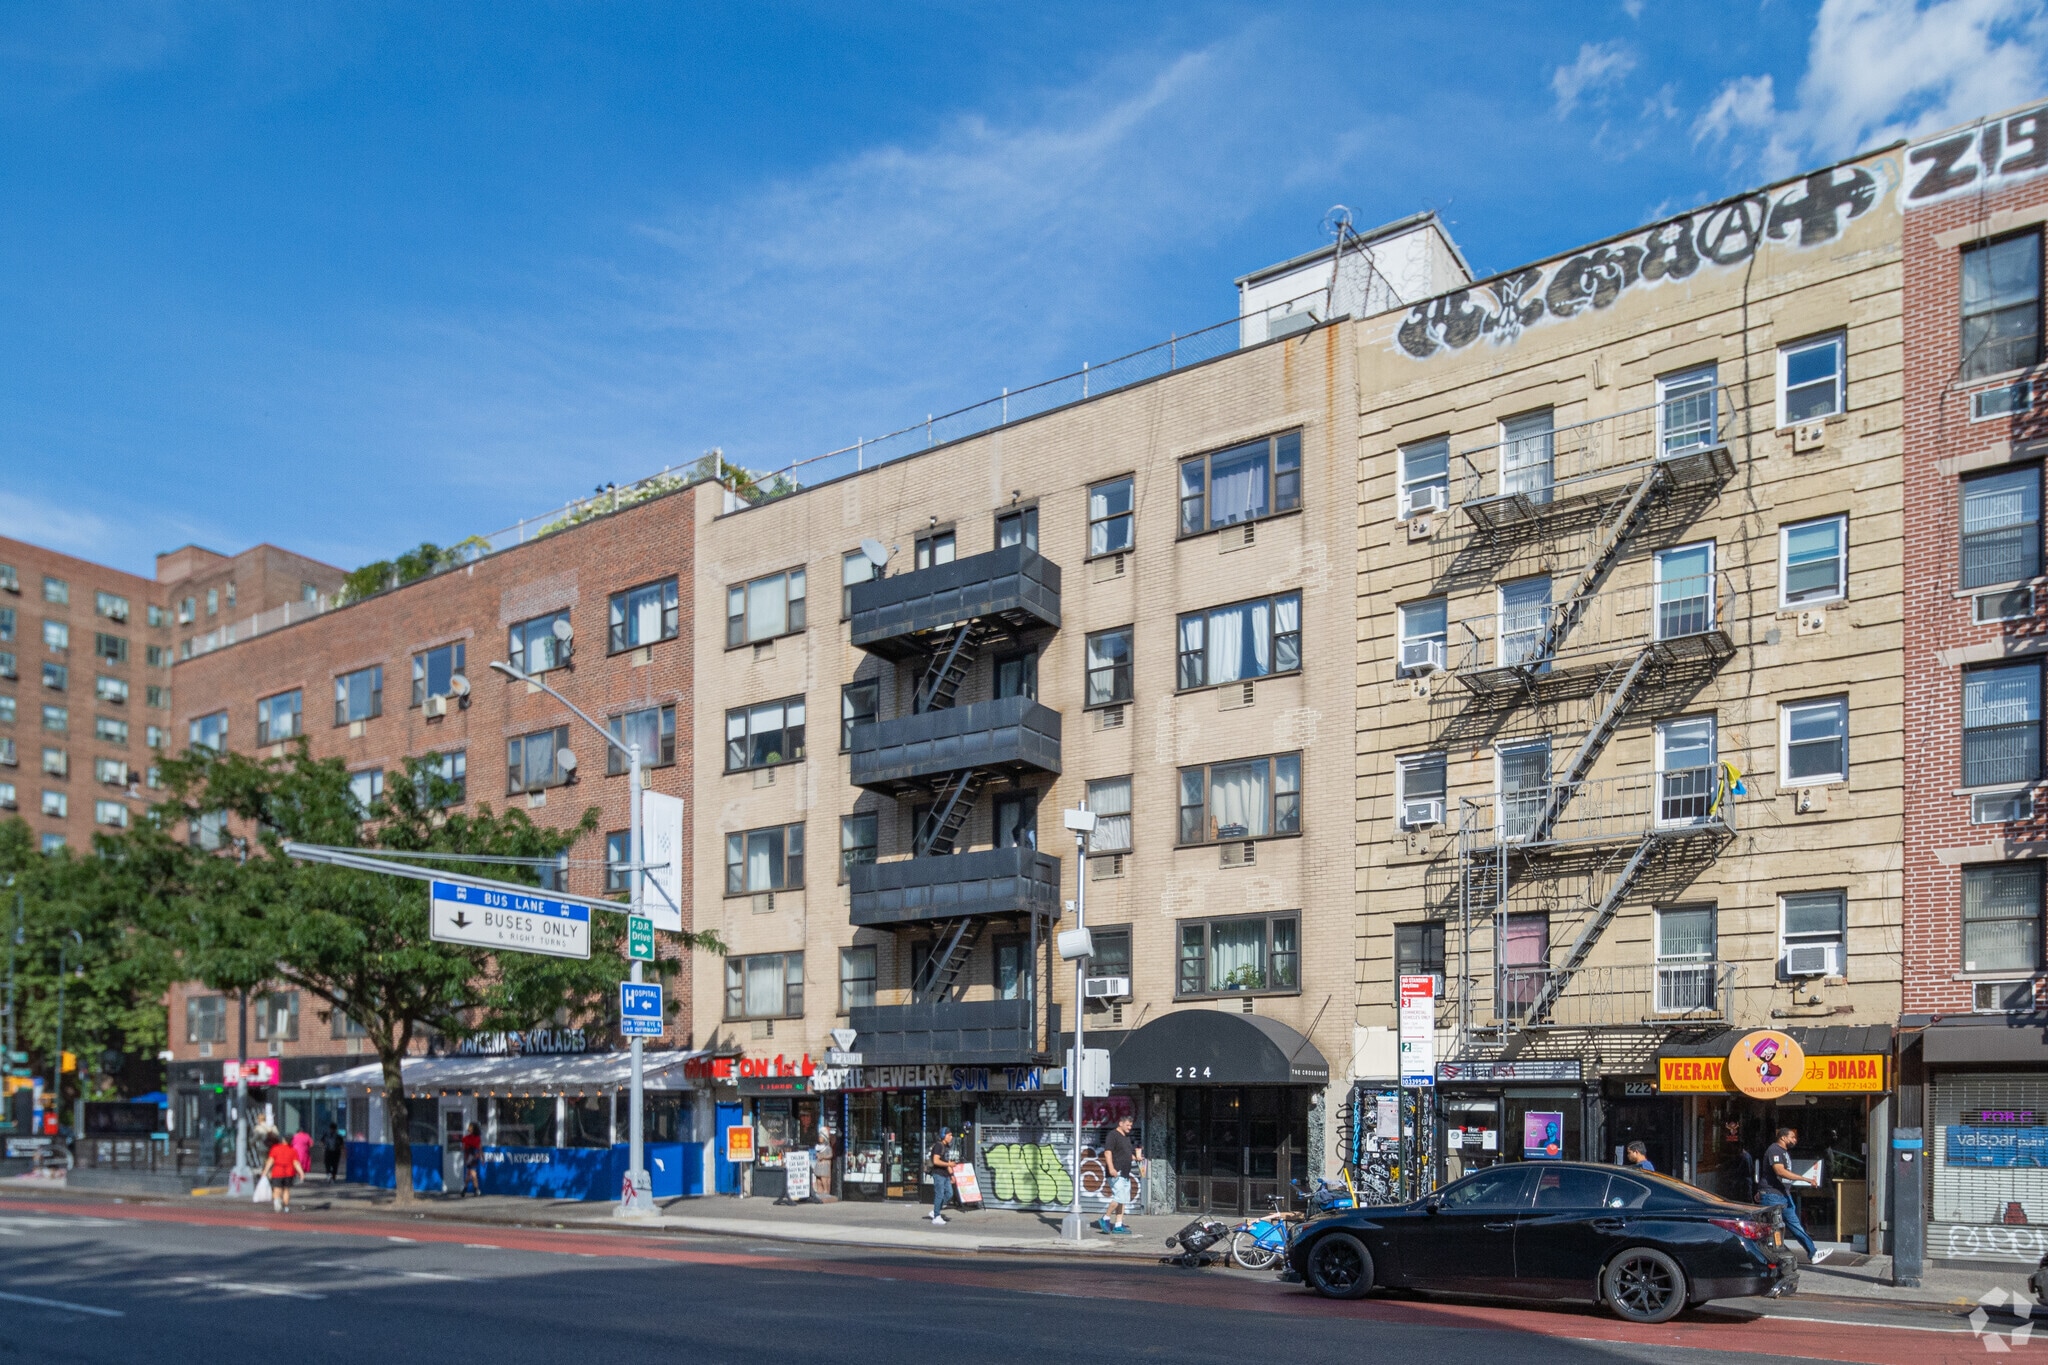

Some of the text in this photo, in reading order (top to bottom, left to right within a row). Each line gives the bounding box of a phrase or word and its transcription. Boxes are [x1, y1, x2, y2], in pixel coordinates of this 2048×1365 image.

[484, 892, 545, 913] BUS LANE
[485, 912, 578, 938] BUSES ONLY
[510, 933, 535, 944] RIGHT
[541, 937, 566, 947] TURNS
[632, 931, 651, 941] Drive
[1404, 999, 1410, 1007] 3
[526, 1029, 586, 1053] KYCLADES
[1404, 1044, 1410, 1052] 2
[684, 1054, 796, 1078] WINE ON 1st
[1663, 1062, 1722, 1081] VEERAY
[1828, 1060, 1877, 1080] DHABA
[813, 1065, 949, 1090] KATHE JEWELRY
[952, 1068, 988, 1092] SUN
[1003, 1066, 1042, 1091] TAN
[1626, 1083, 1650, 1094] 222
[1956, 1131, 2017, 1150] valspar
